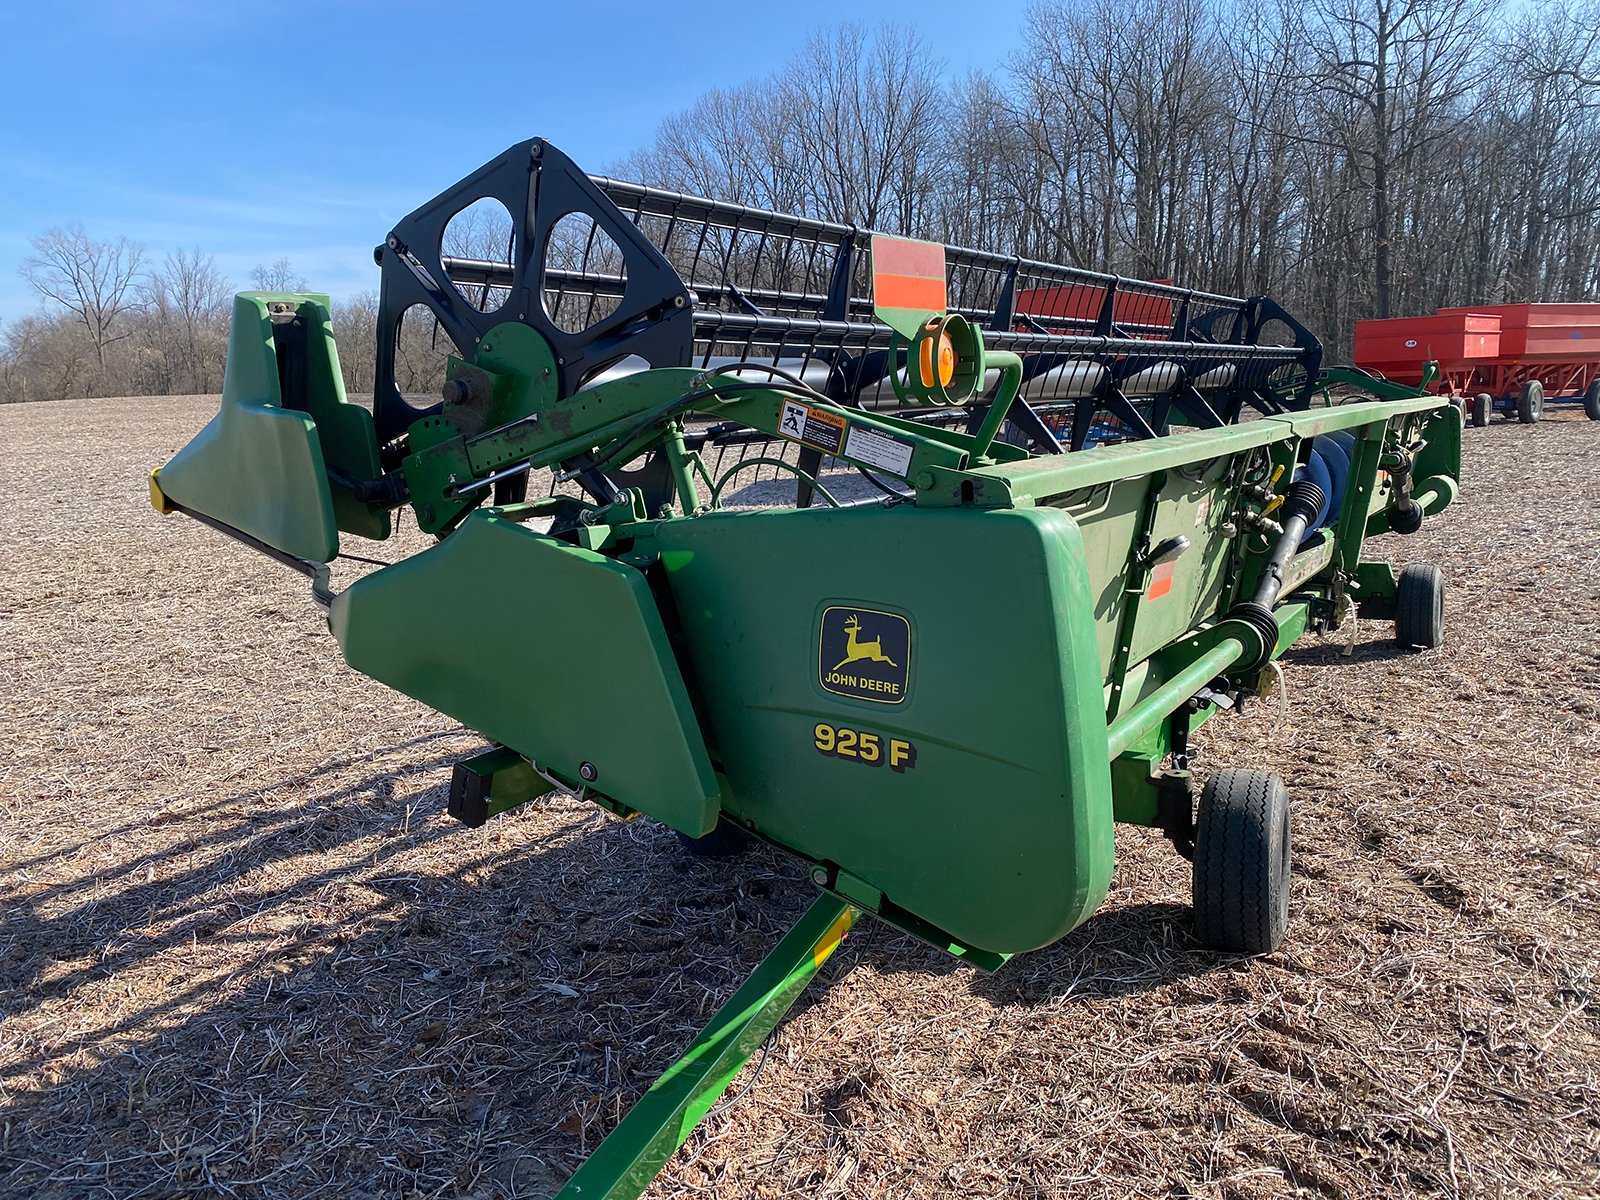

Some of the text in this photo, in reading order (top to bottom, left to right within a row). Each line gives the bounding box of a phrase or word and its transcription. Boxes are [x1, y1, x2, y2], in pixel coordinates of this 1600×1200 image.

[816, 413, 842, 425] WARNING
[825, 672, 900, 695] JOHN DEERE
[813, 723, 913, 769] 925 F
